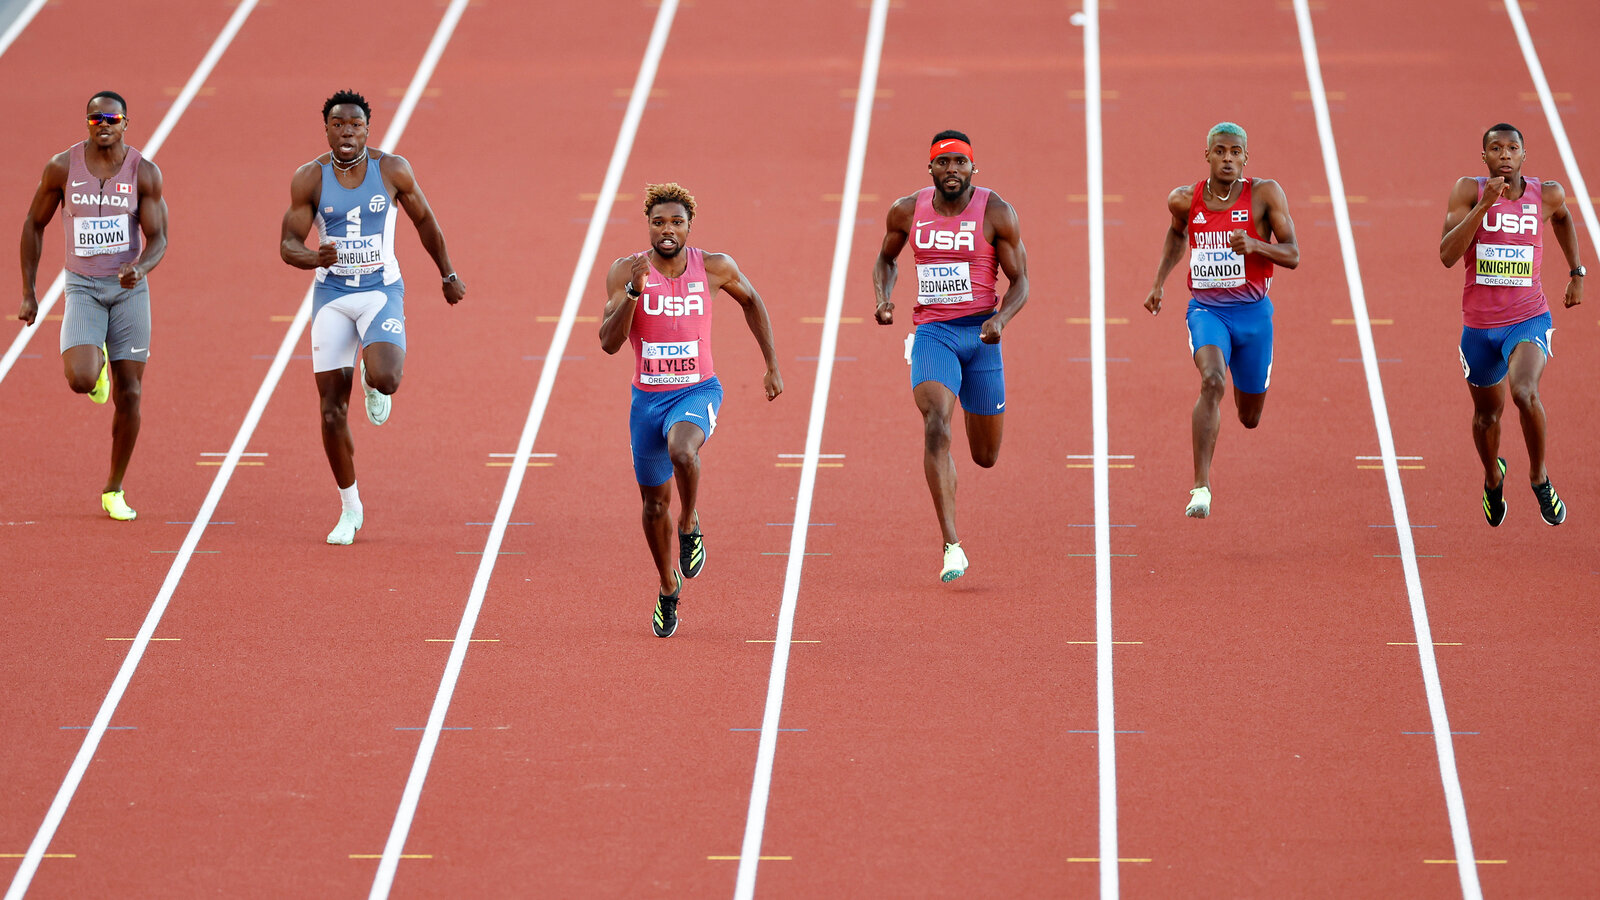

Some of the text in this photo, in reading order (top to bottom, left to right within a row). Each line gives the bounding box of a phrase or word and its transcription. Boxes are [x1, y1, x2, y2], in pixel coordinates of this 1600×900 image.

[72, 194, 128, 208] CANADA
[89, 218, 120, 229] TDK
[1482, 212, 1538, 235] USA
[80, 230, 124, 244] BROWN
[915, 229, 974, 251] USA
[342, 239, 373, 249] TDK
[1205, 252, 1235, 261] TDK
[1495, 247, 1526, 258] TDK
[929, 266, 960, 276] TDK
[1193, 264, 1241, 277] OGANDO
[1479, 260, 1530, 274] KNIGHTON
[921, 278, 968, 292] BEDNAREK
[643, 293, 703, 316] USA
[924, 296, 963, 304] OREGON22
[656, 345, 690, 355] TDK
[644, 358, 695, 372] N. LYLES
